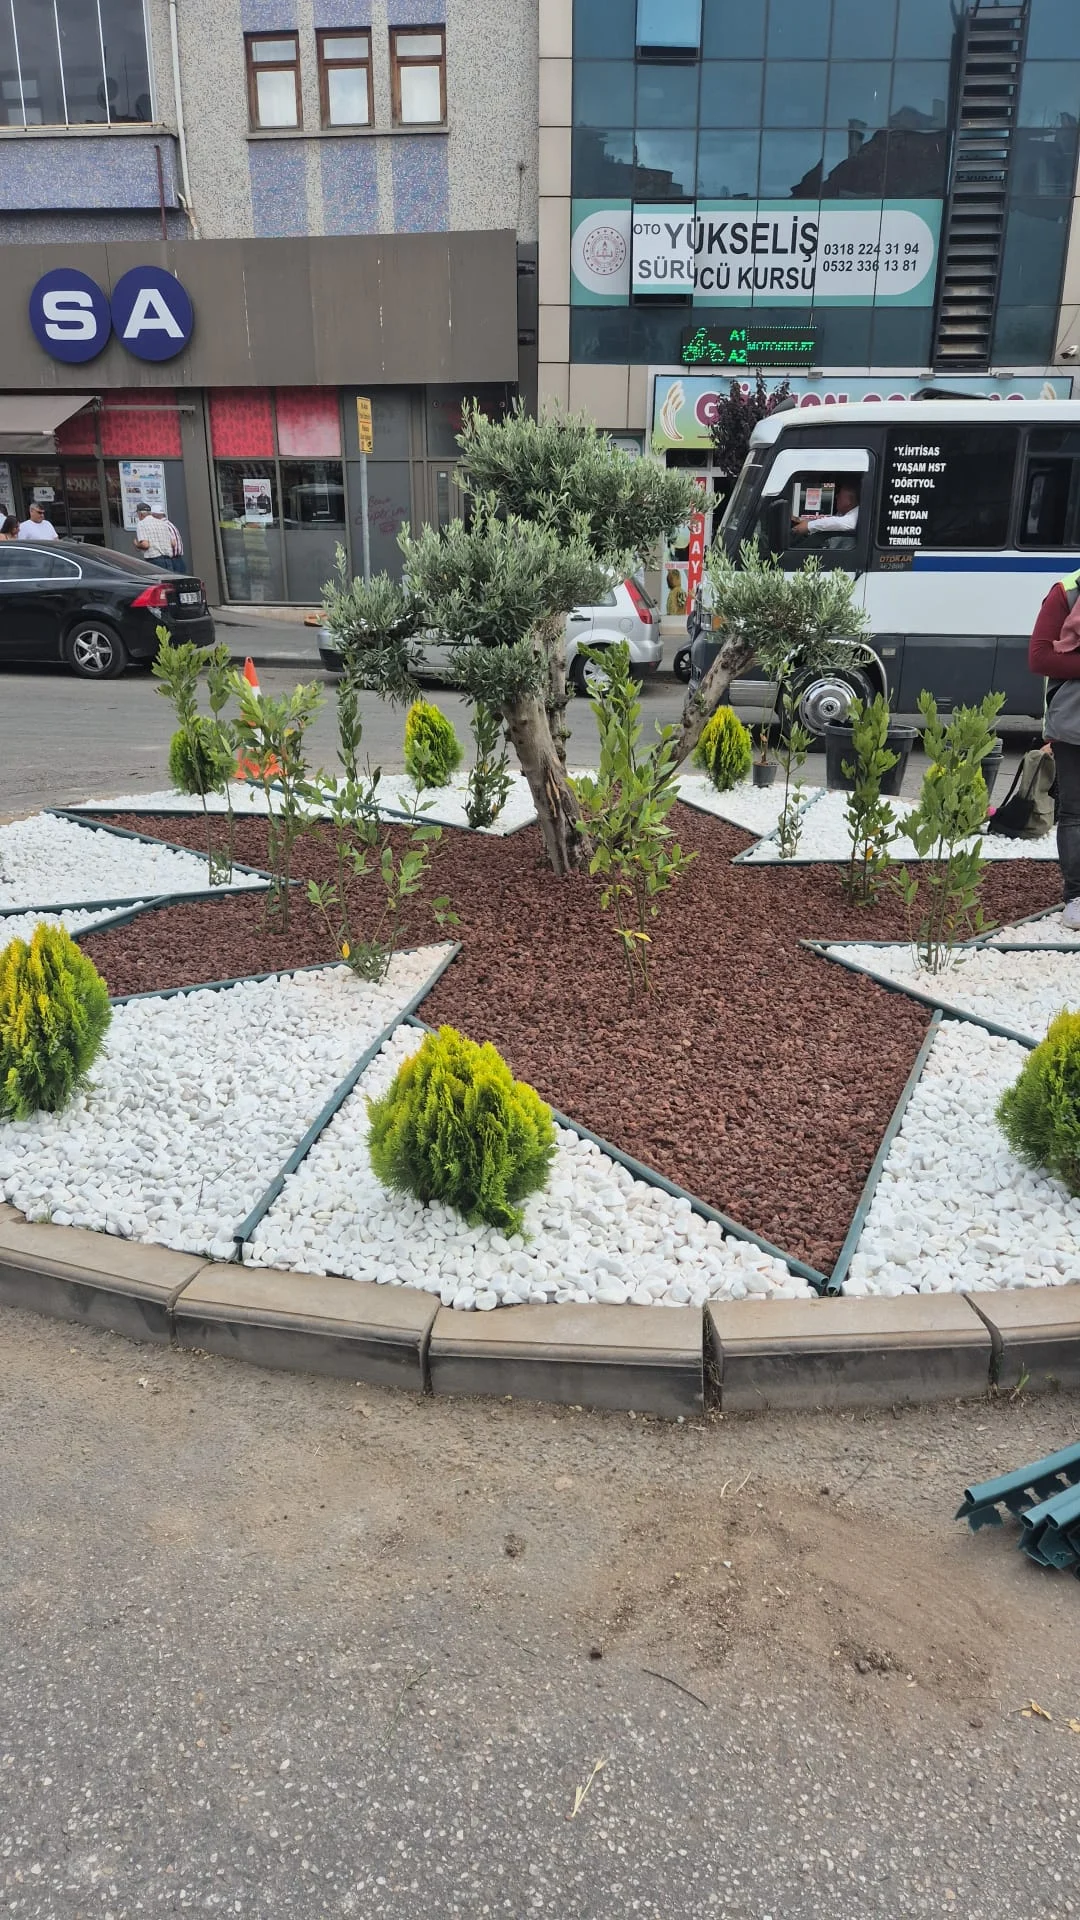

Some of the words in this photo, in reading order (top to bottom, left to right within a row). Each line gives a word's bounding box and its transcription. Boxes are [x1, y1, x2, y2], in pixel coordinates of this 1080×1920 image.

[633, 223, 661, 235] OTO
[664, 216, 818, 262] YÜKSELİŞ
[824, 243, 854, 255] 0318
[858, 243, 880, 255] 224
[885, 243, 899, 255] 31
[904, 243, 919, 254] 94
[823, 260, 853, 272] 0532
[857, 260, 879, 272] 336
[884, 260, 898, 272] 13
[902, 259, 917, 272] 81
[638, 256, 730, 290] SÜRÜCÜ
[737, 267, 816, 290] KURSU
[729, 329, 746, 341] A1
[728, 349, 746, 362] A2
[928, 462, 947, 472] HST
[888, 536, 922, 546] TERMİNAL
